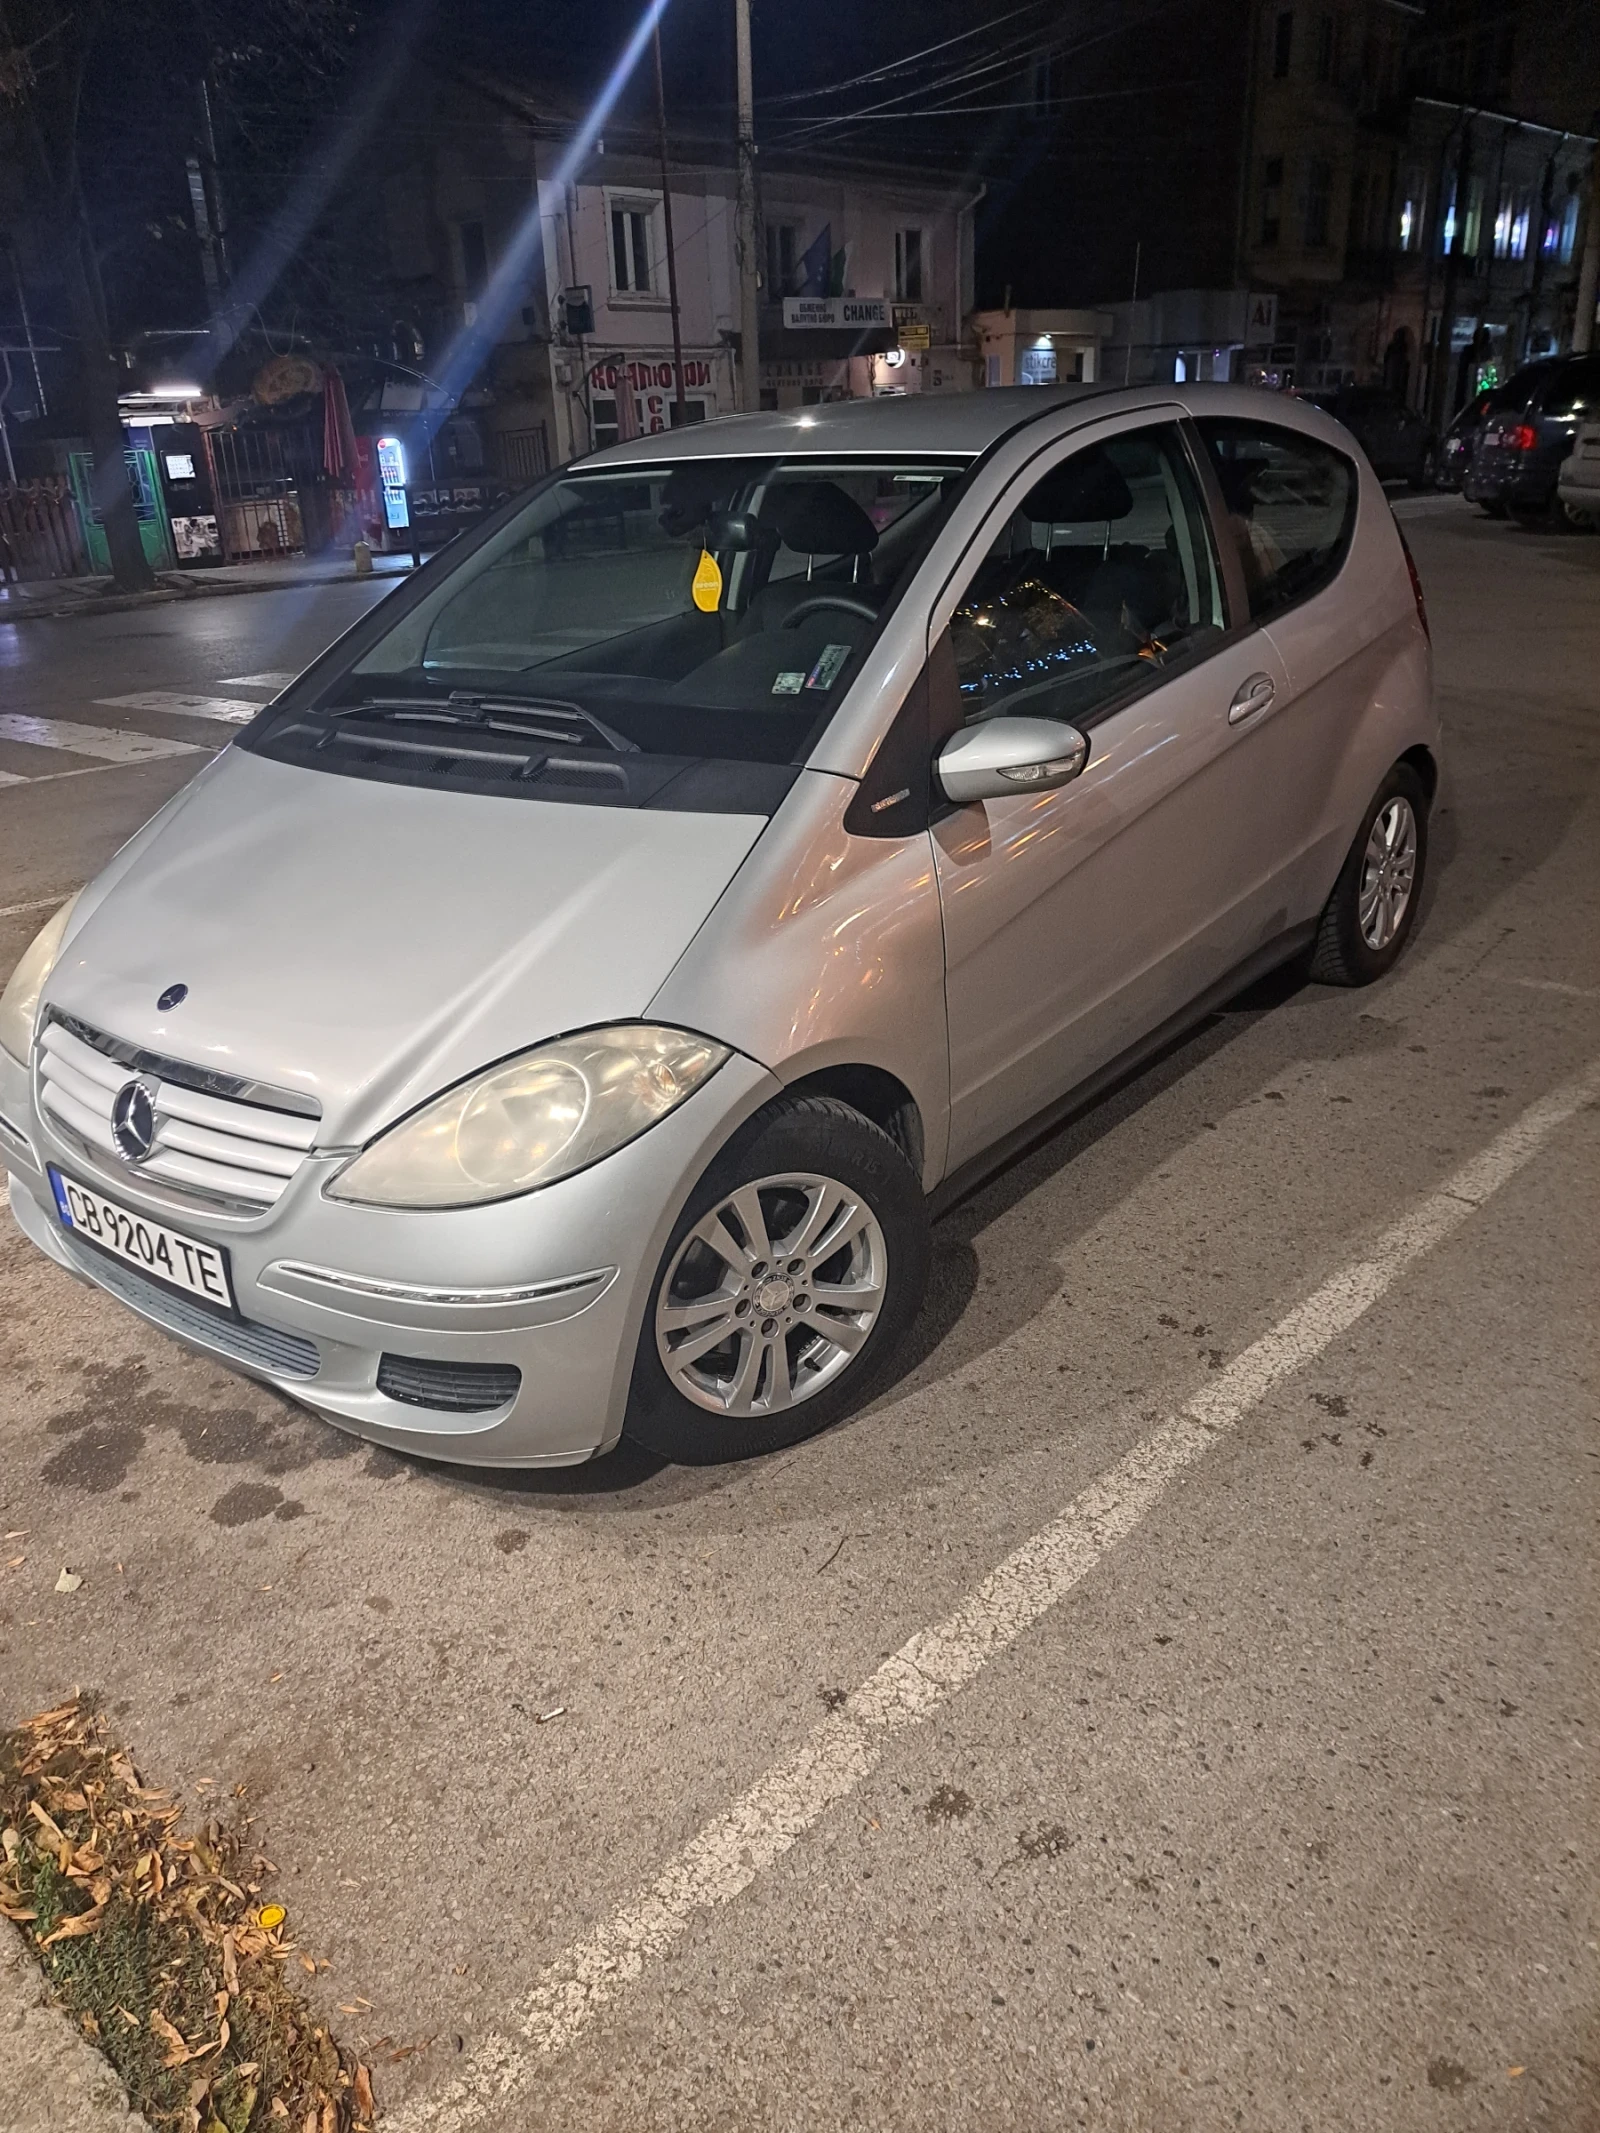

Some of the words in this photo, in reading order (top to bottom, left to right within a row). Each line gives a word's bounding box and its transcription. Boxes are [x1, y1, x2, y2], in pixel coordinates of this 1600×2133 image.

[843, 304, 885, 321] CHANGE
[591, 361, 711, 391] КОПЮРИ
[67, 1185, 103, 1237] CB
[103, 1205, 174, 1276] 9204
[174, 1238, 223, 1298] TE
